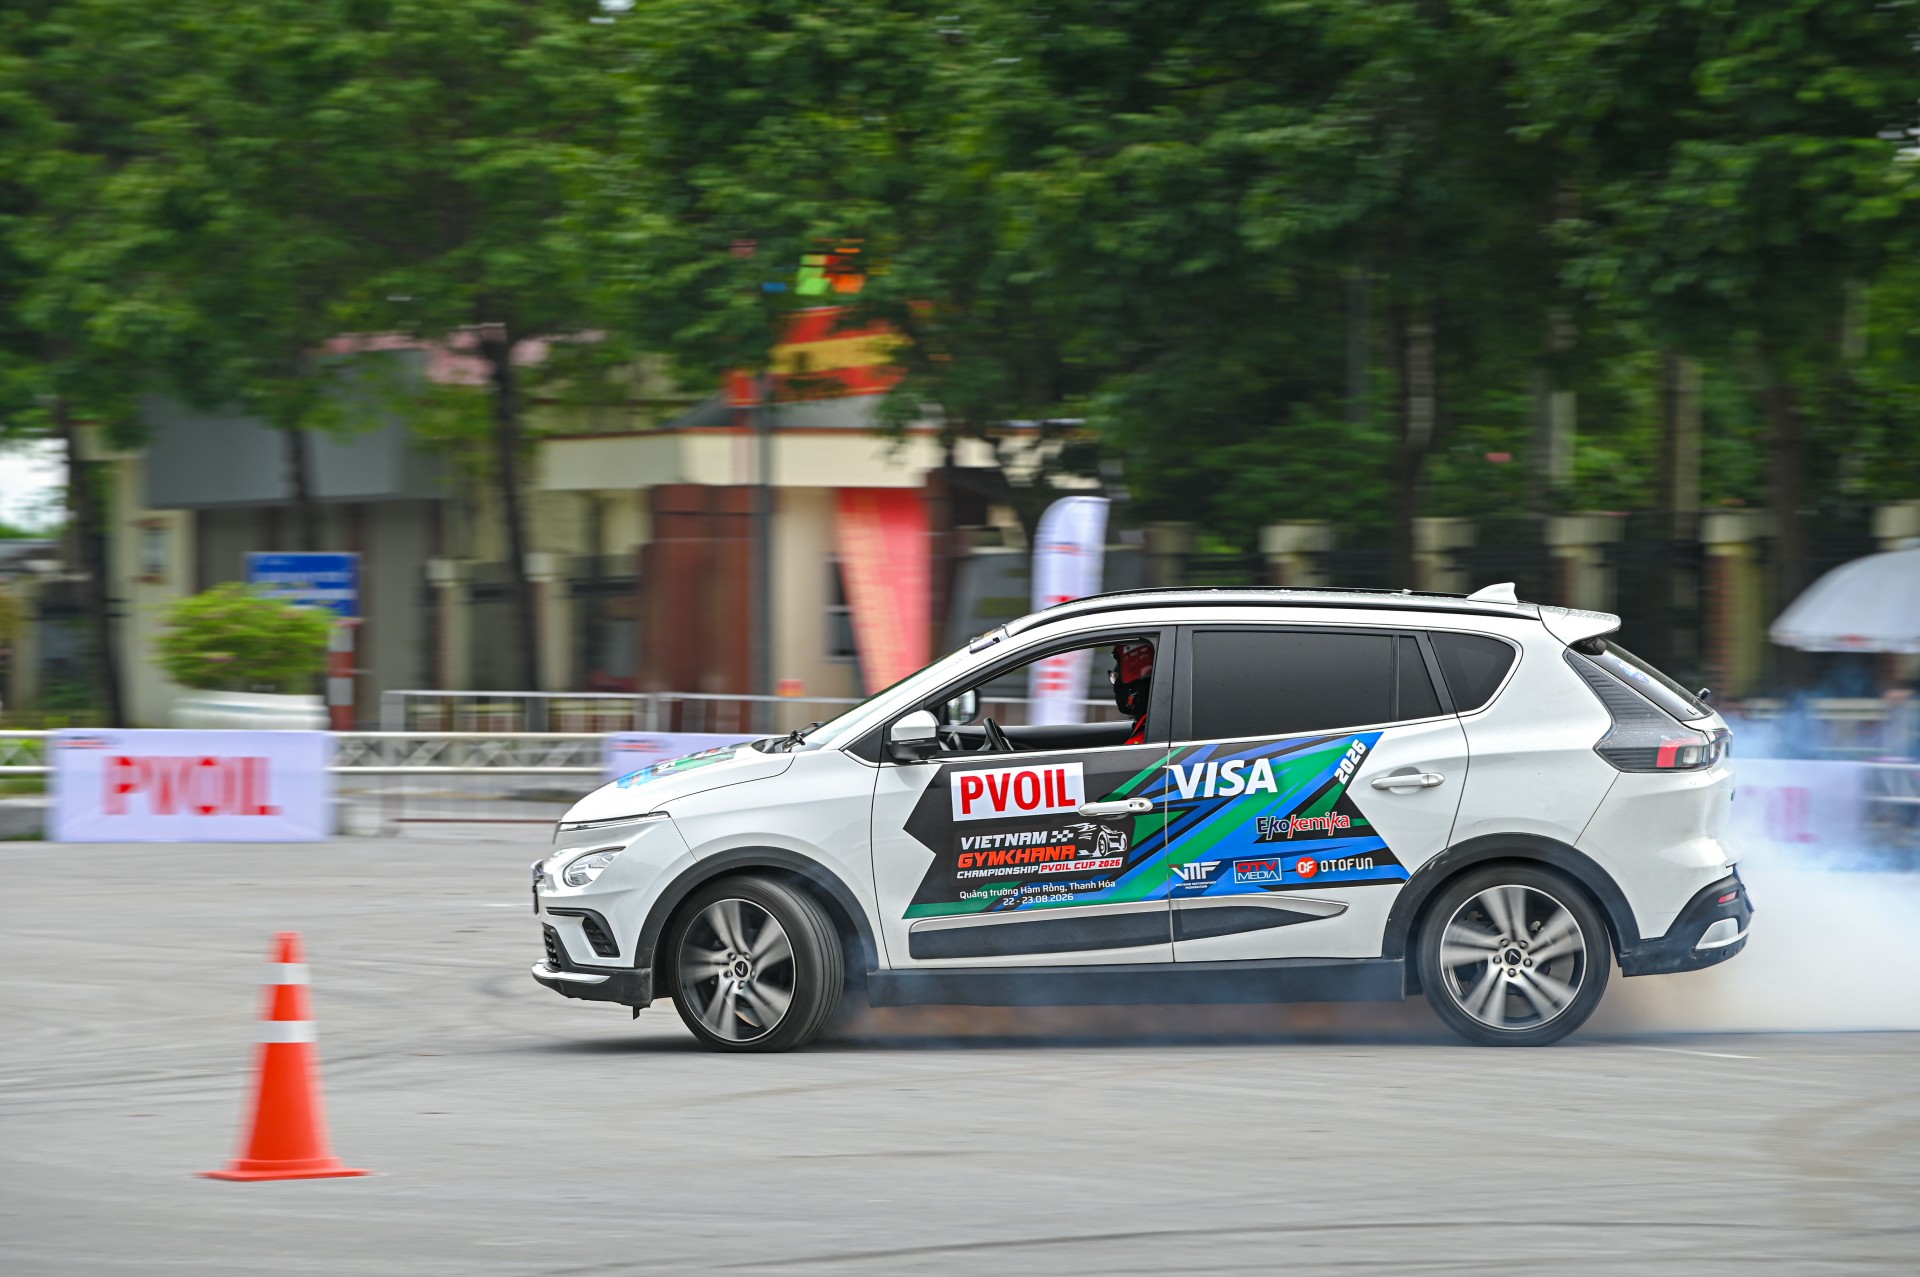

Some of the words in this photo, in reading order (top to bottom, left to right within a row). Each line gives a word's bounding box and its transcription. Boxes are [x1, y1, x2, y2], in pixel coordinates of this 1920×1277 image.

[1334, 739, 1367, 785] 2026
[104, 756, 284, 815] PVOIL
[1162, 758, 1278, 799] VISA
[960, 769, 1076, 814] PVOIL
[1256, 811, 1351, 840] Ekokemika
[960, 830, 1048, 850] VIETNAM
[957, 844, 1076, 868] GYMKHANA
[1320, 857, 1373, 872] OTOFUN
[956, 866, 1039, 879] CHAMPIONSHIP
[1040, 863, 1071, 873] PVOIL
[1074, 861, 1096, 870] CUP
[1098, 858, 1121, 868] 2026
[1238, 870, 1279, 880] MEDIA
[959, 889, 988, 900] Quảng
[989, 887, 1019, 897] trường
[1020, 886, 1041, 895] Hàm
[1043, 882, 1068, 893] Rồng,
[1069, 881, 1097, 891] Thanh
[1098, 879, 1116, 888] Hóa
[1003, 897, 1015, 906] 22
[1022, 893, 1074, 904] 23.08.2026
